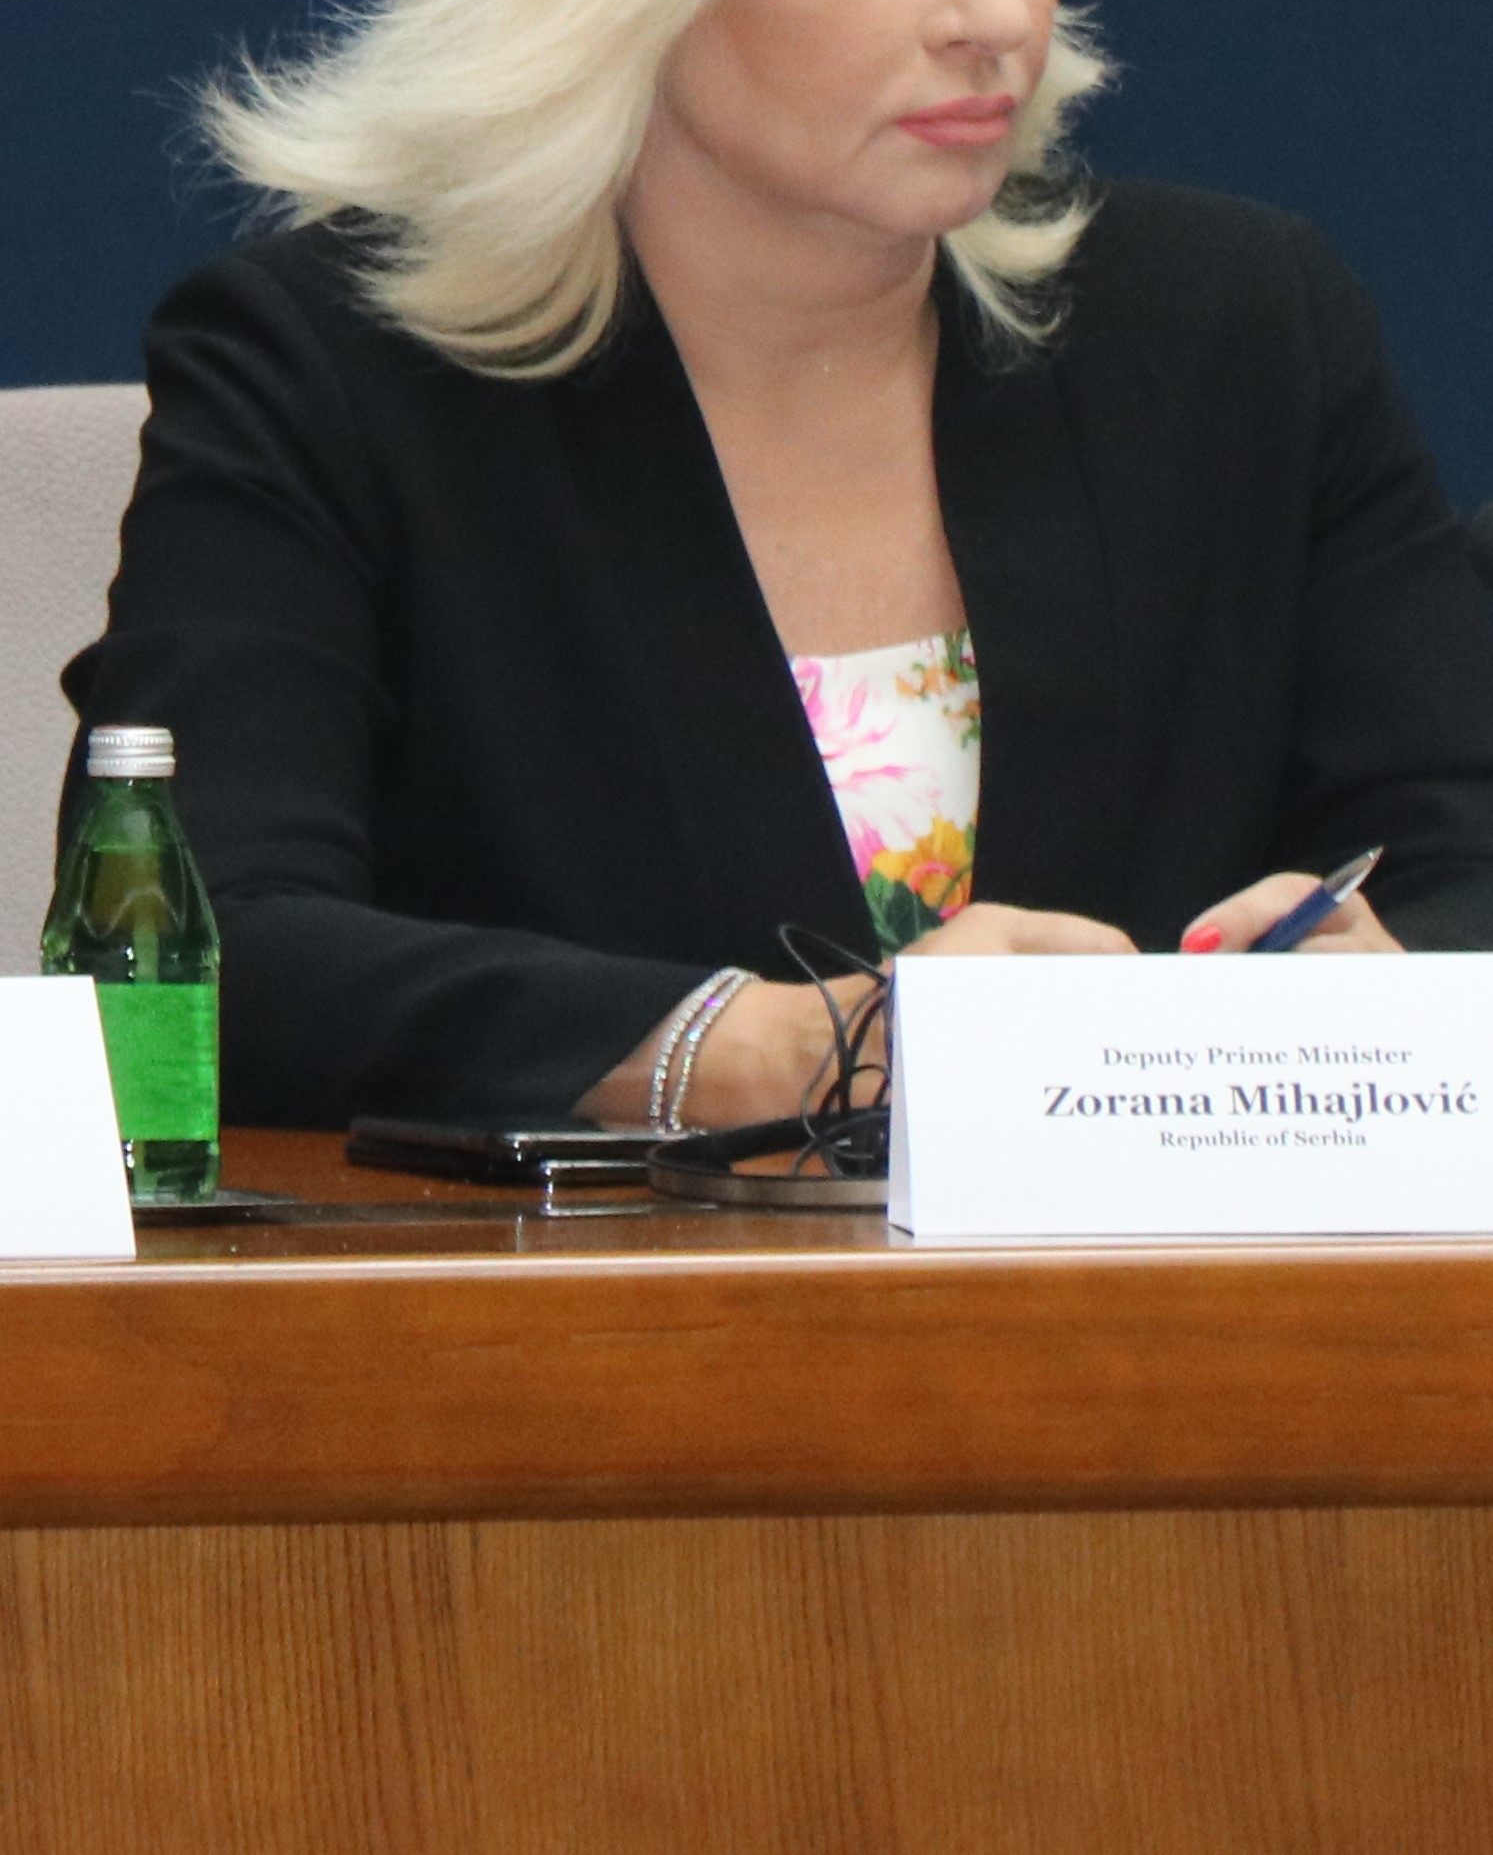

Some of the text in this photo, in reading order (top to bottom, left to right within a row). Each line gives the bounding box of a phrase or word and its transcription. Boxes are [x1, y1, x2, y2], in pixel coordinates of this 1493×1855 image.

[1102, 1045, 1413, 1071] Deputy Prime Minister
[1043, 1081, 1478, 1124] Zorana Mihajlović
[1159, 1129, 1367, 1151] Republic of Serbia
